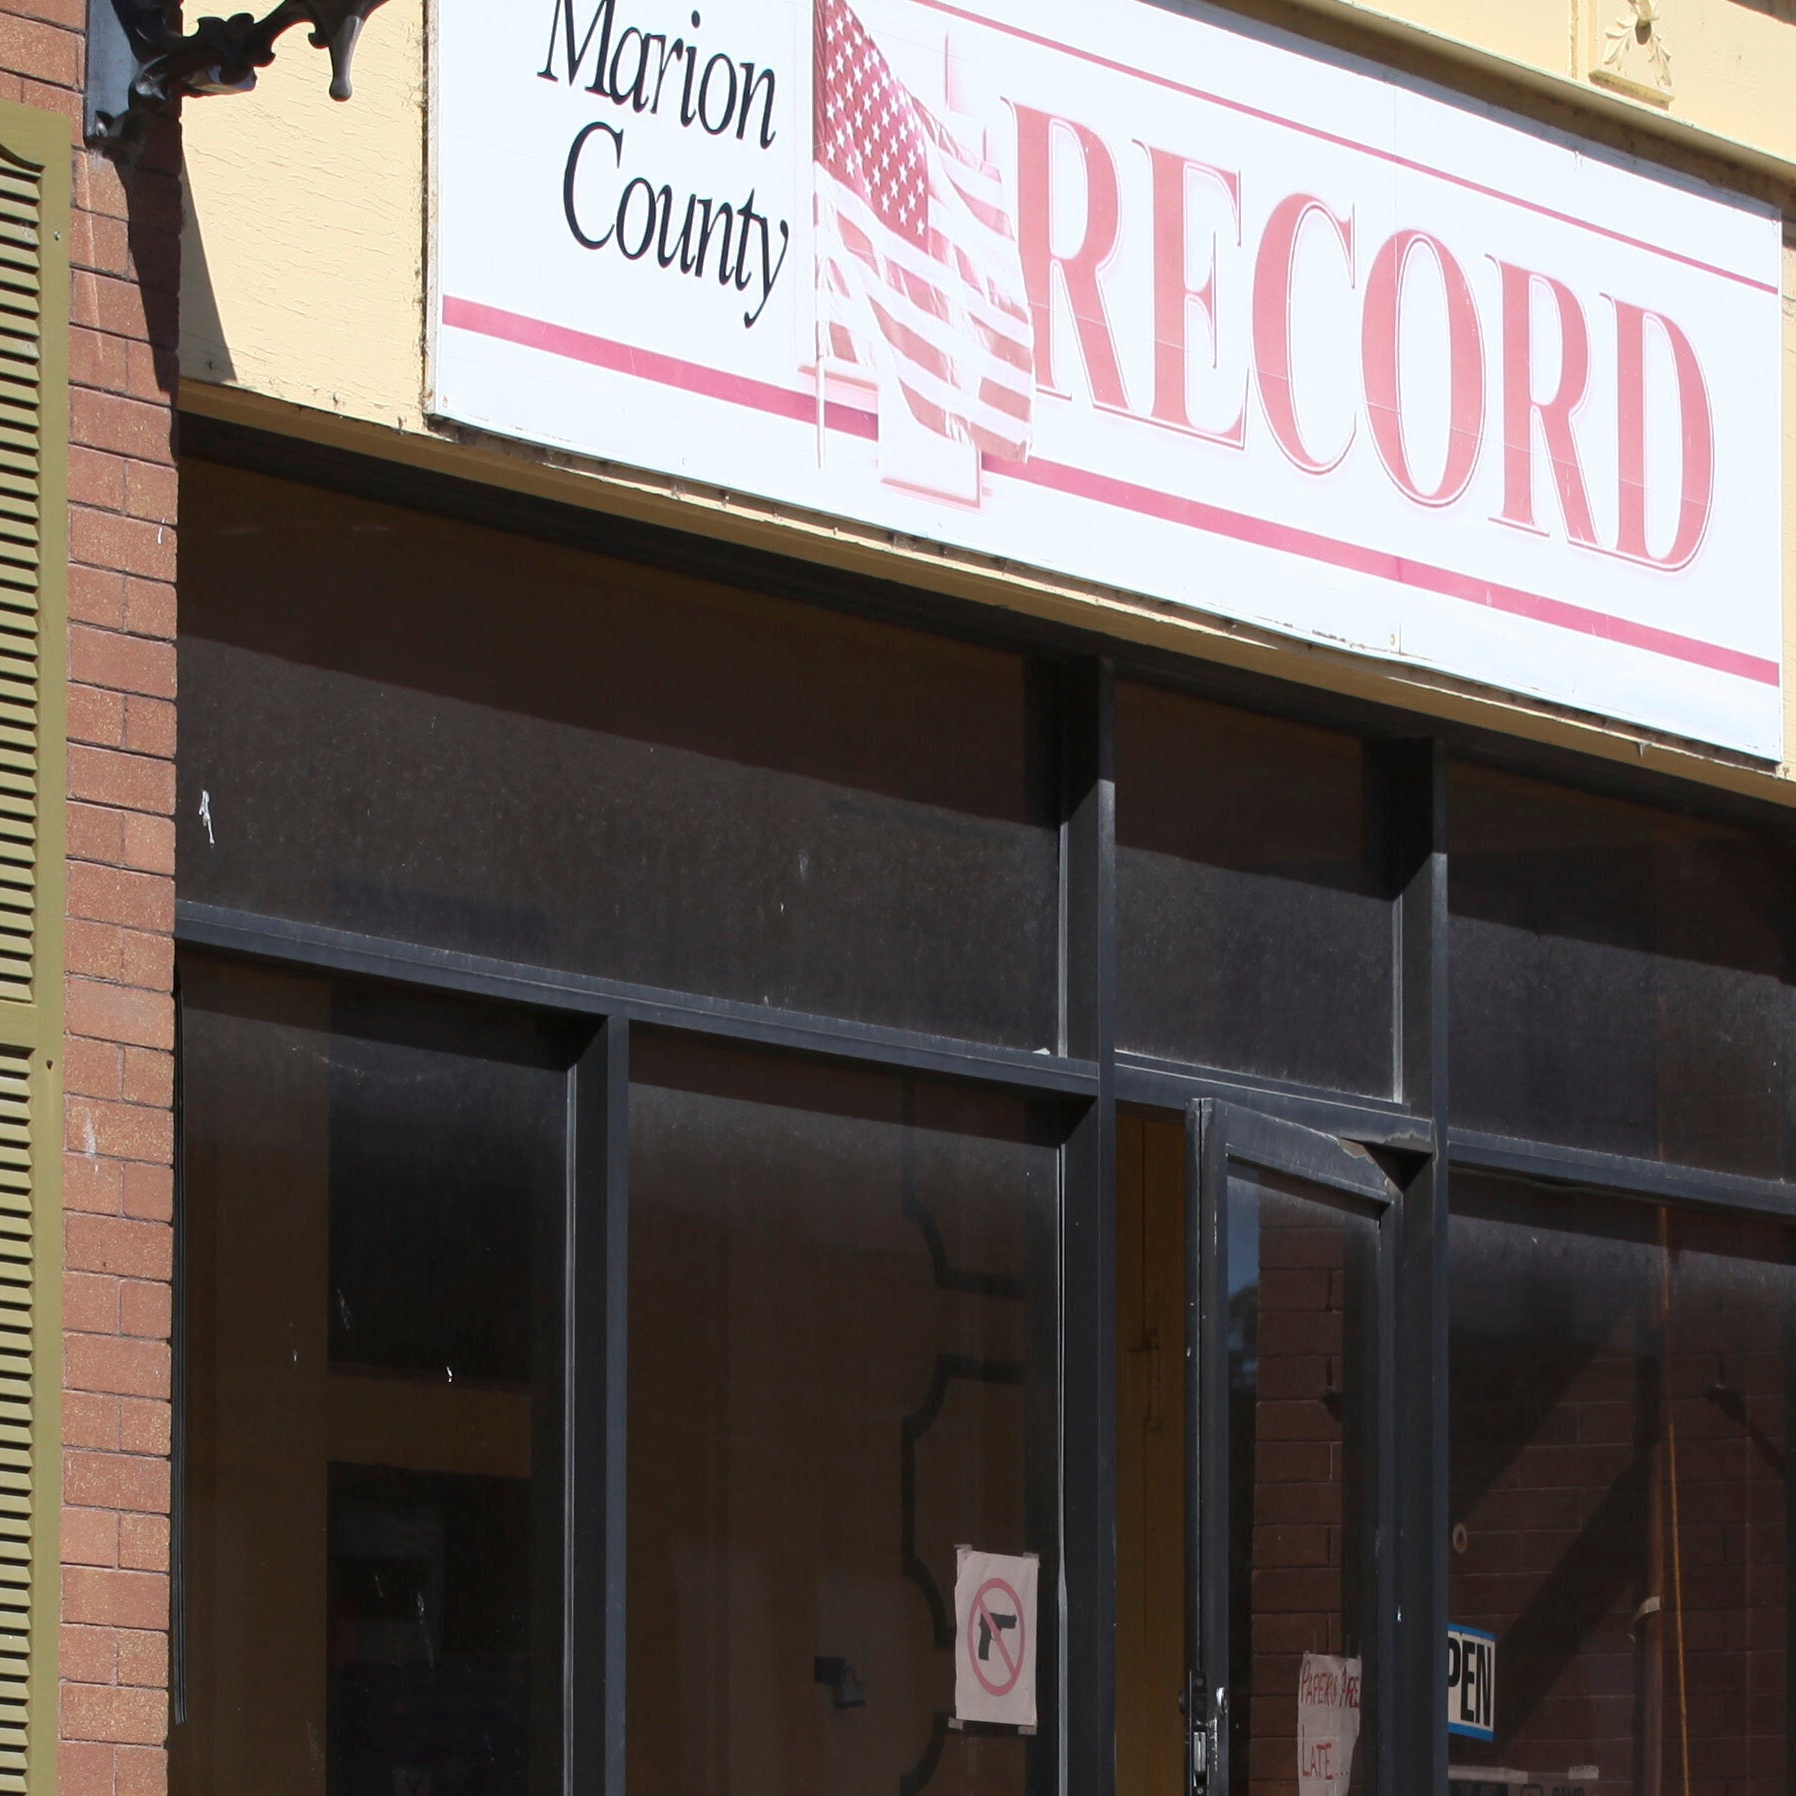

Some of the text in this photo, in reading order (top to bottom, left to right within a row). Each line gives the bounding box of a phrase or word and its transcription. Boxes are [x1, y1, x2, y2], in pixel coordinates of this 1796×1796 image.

[537, 0, 777, 149] Marion
[563, 121, 789, 328] County
[1001, 96, 1714, 572] RECORD
[1448, 1637, 1491, 1727] PEN
